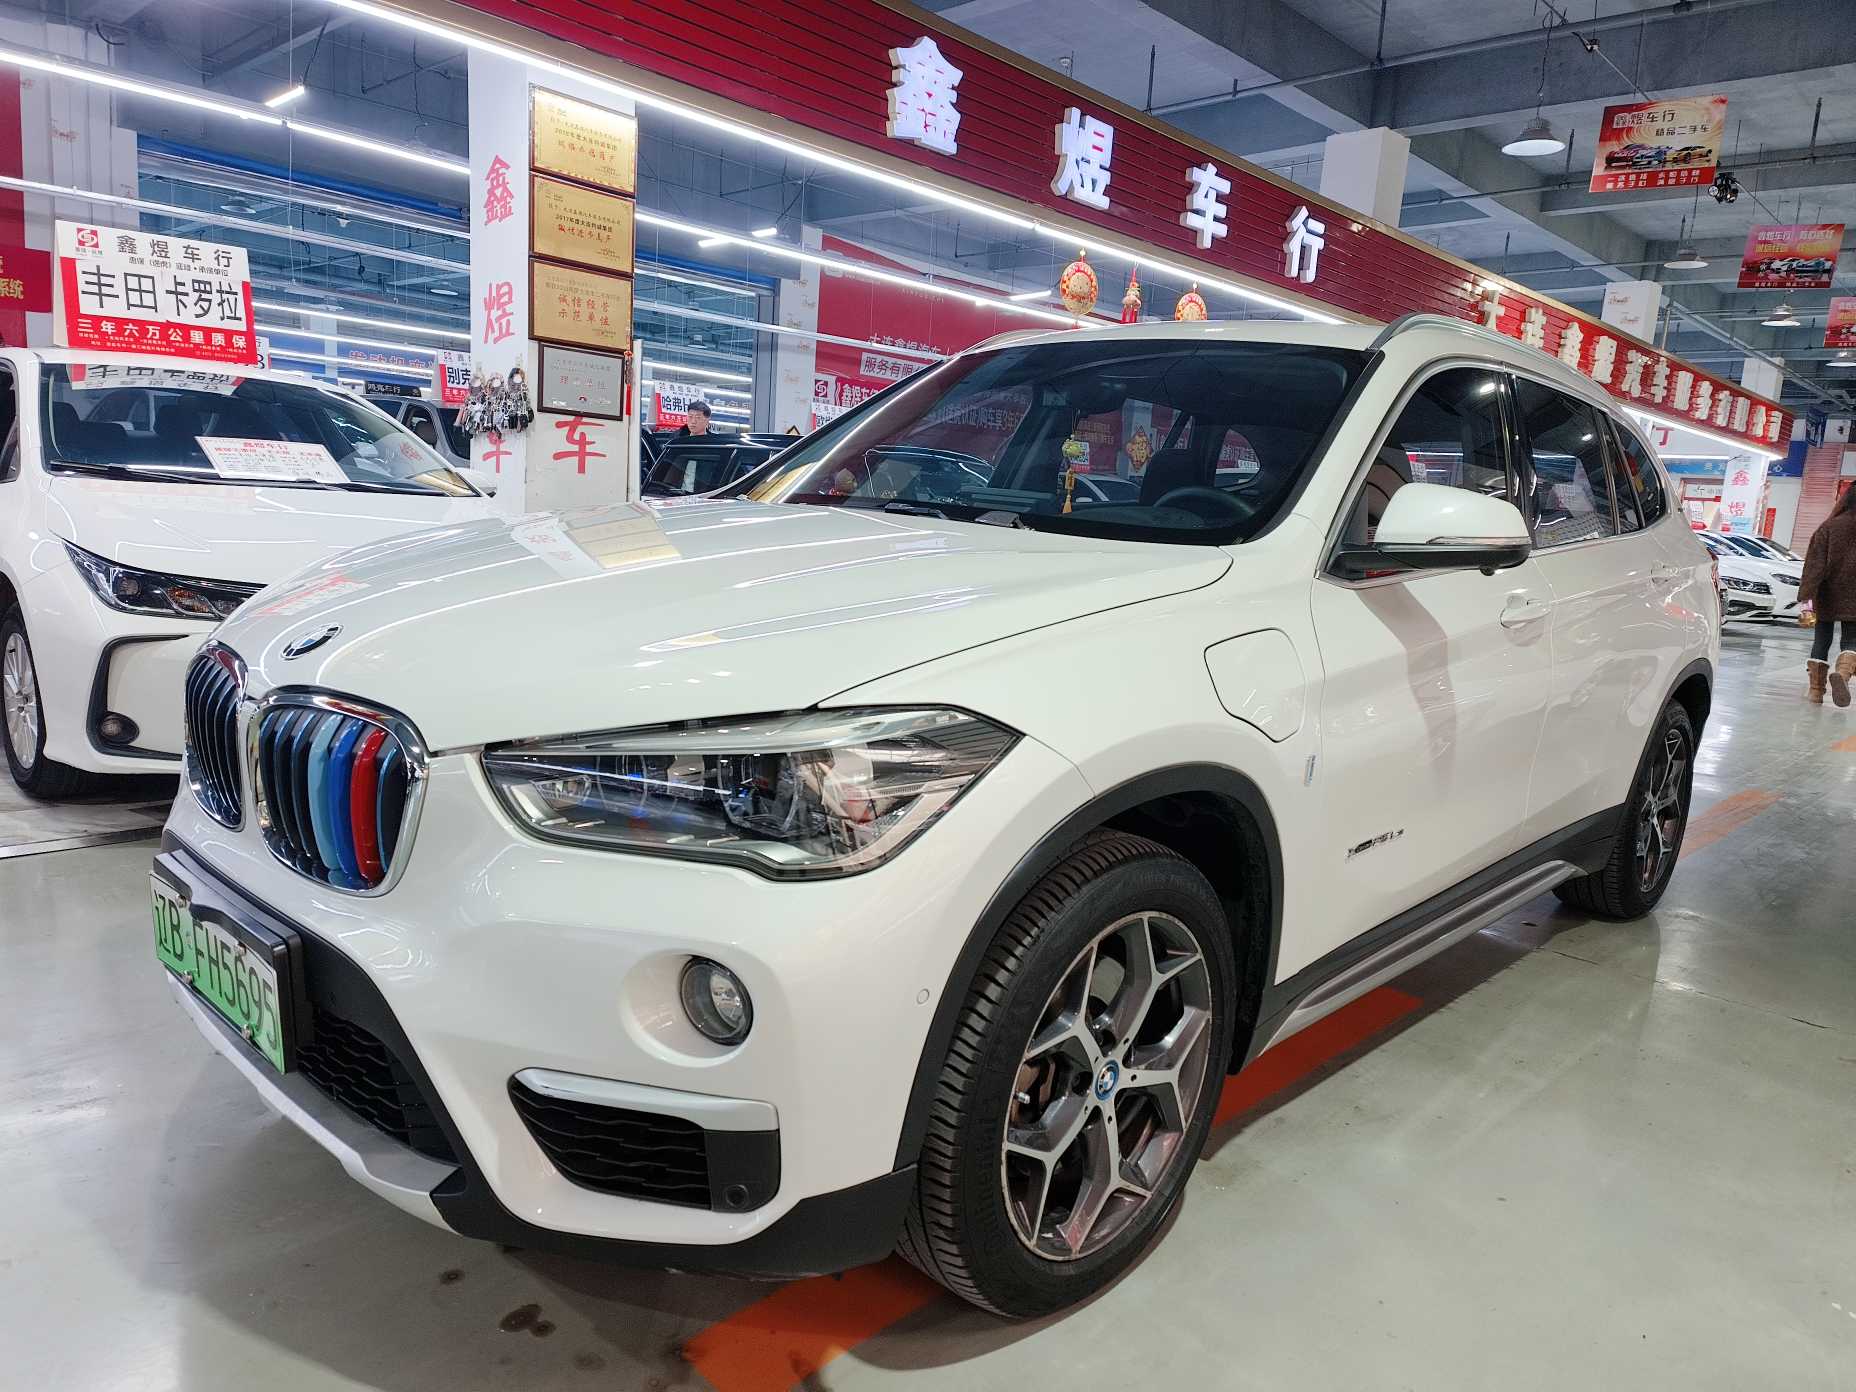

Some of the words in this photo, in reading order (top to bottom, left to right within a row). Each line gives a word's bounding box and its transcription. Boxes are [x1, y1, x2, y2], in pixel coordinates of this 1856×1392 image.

[1613, 109, 1677, 128] 鑫煜车行
[116, 234, 233, 269] 鑫煜车行
[77, 318, 247, 349] 三年六万公里质保
